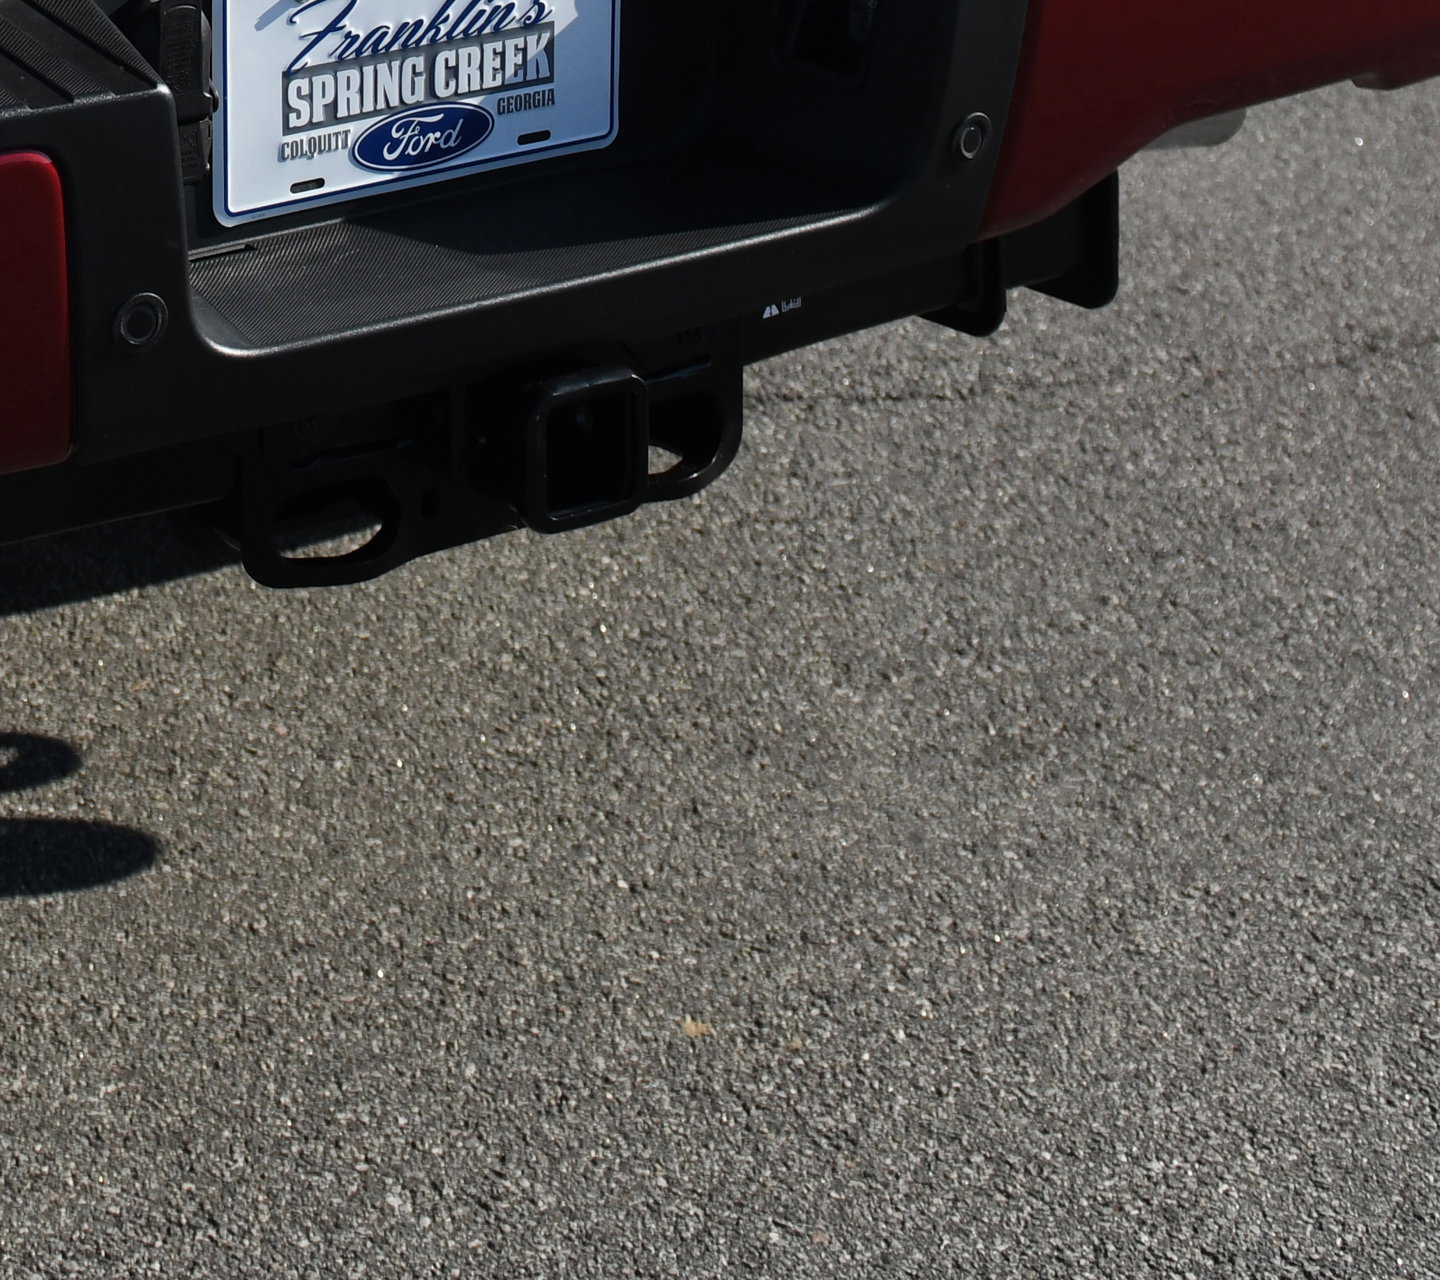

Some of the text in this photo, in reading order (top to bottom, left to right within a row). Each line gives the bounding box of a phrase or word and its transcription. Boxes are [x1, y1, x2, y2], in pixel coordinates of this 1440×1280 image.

[286, 33, 552, 129] SPRING CREEK
[496, 88, 557, 117] GEORGIA
[280, 129, 351, 162] COLQUITT
[383, 112, 462, 161] Ford
